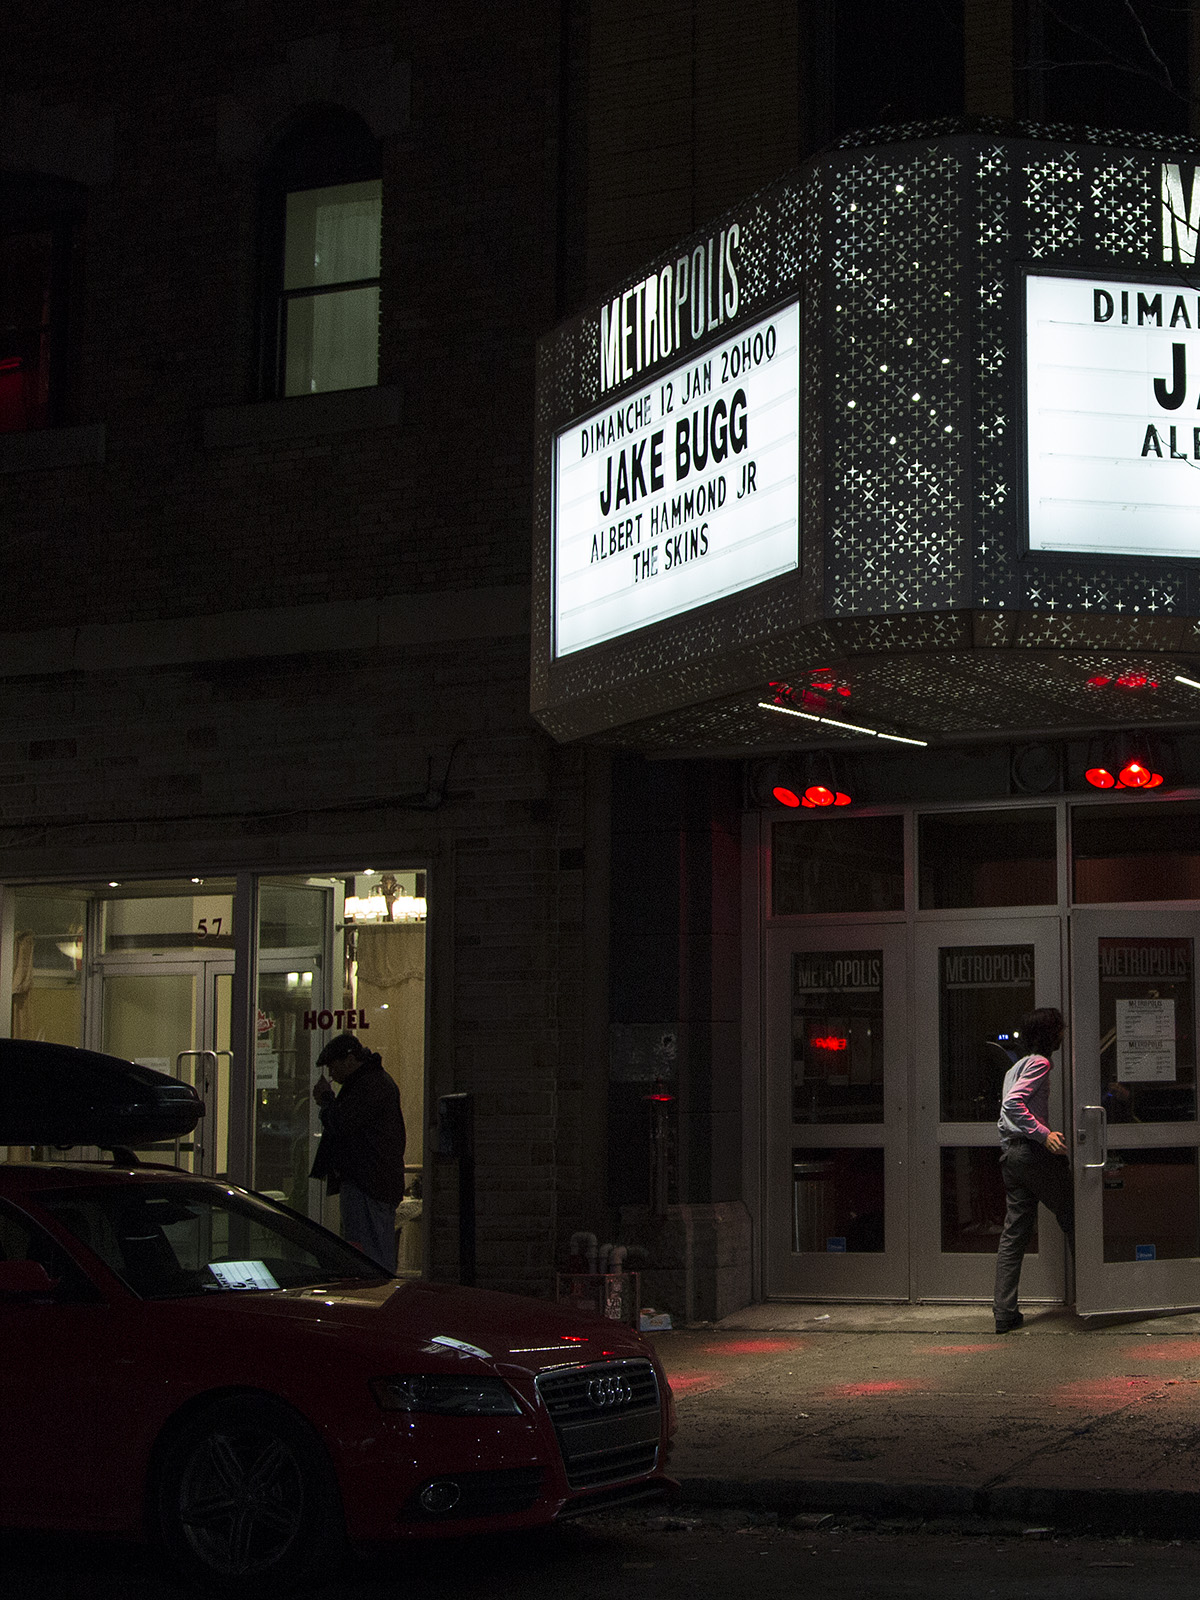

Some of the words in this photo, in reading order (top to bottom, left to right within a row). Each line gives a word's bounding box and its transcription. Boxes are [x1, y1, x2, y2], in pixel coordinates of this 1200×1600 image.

[601, 223, 740, 392] METROPOLIS
[581, 394, 652, 458] DIMANCHE
[661, 382, 674, 415] 12
[682, 359, 712, 405] JAN
[599, 429, 664, 517] JAKE
[675, 388, 748, 481] BUGG
[590, 513, 643, 564] ALBERT
[650, 476, 727, 537] HAMMOND
[737, 460, 757, 500] JR
[633, 545, 658, 583] THE
[664, 523, 709, 570] SKINS
[800, 959, 880, 987] METROPOLIS
[945, 953, 1031, 982] METROPOLIS
[1101, 948, 1188, 975] METROPOLIS
[303, 1009, 370, 1030] HOTEL
